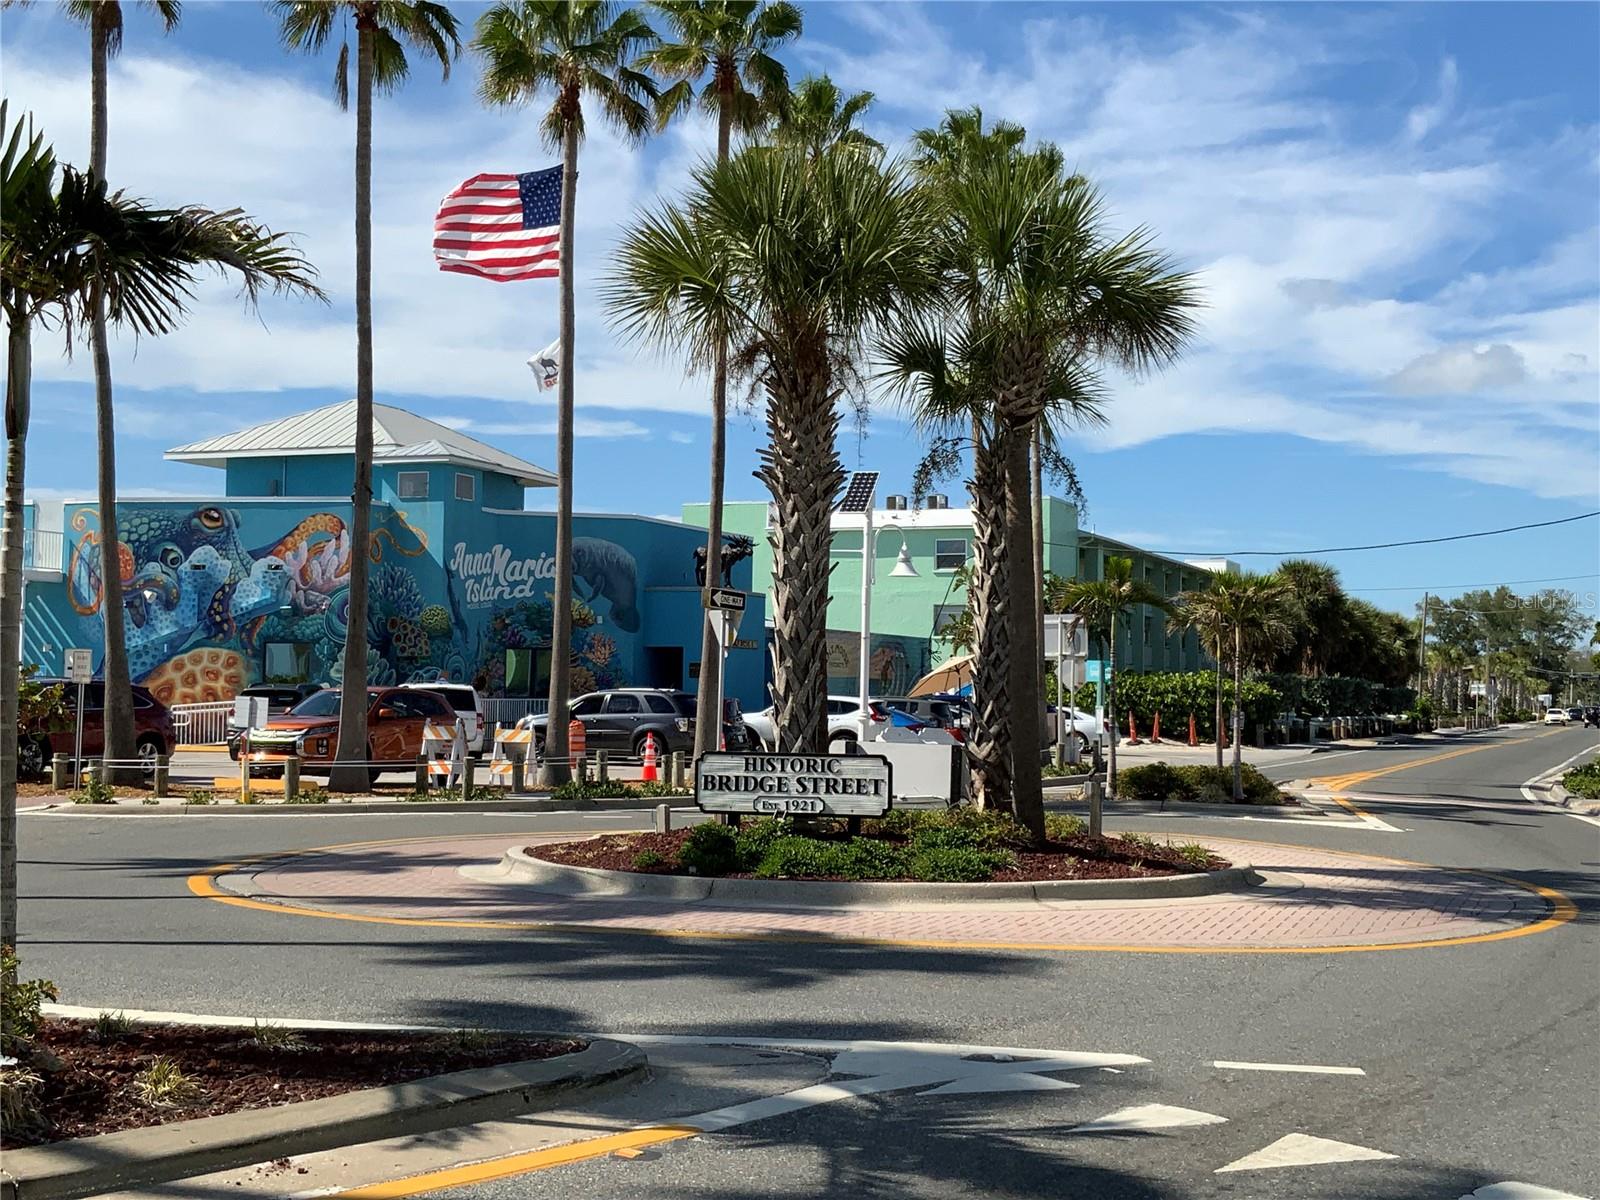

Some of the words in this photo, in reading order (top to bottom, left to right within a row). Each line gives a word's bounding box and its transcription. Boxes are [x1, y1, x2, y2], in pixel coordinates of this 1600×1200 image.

[450, 542, 492, 580] Anna
[487, 544, 557, 586] Maria
[465, 576, 534, 603] Island
[720, 595, 731, 604] ONE
[732, 597, 743, 606] WAY
[743, 757, 841, 774] HISTORIC
[702, 774, 789, 793] BRIDGE
[795, 776, 886, 796] STREET
[785, 800, 817, 812] 1921
